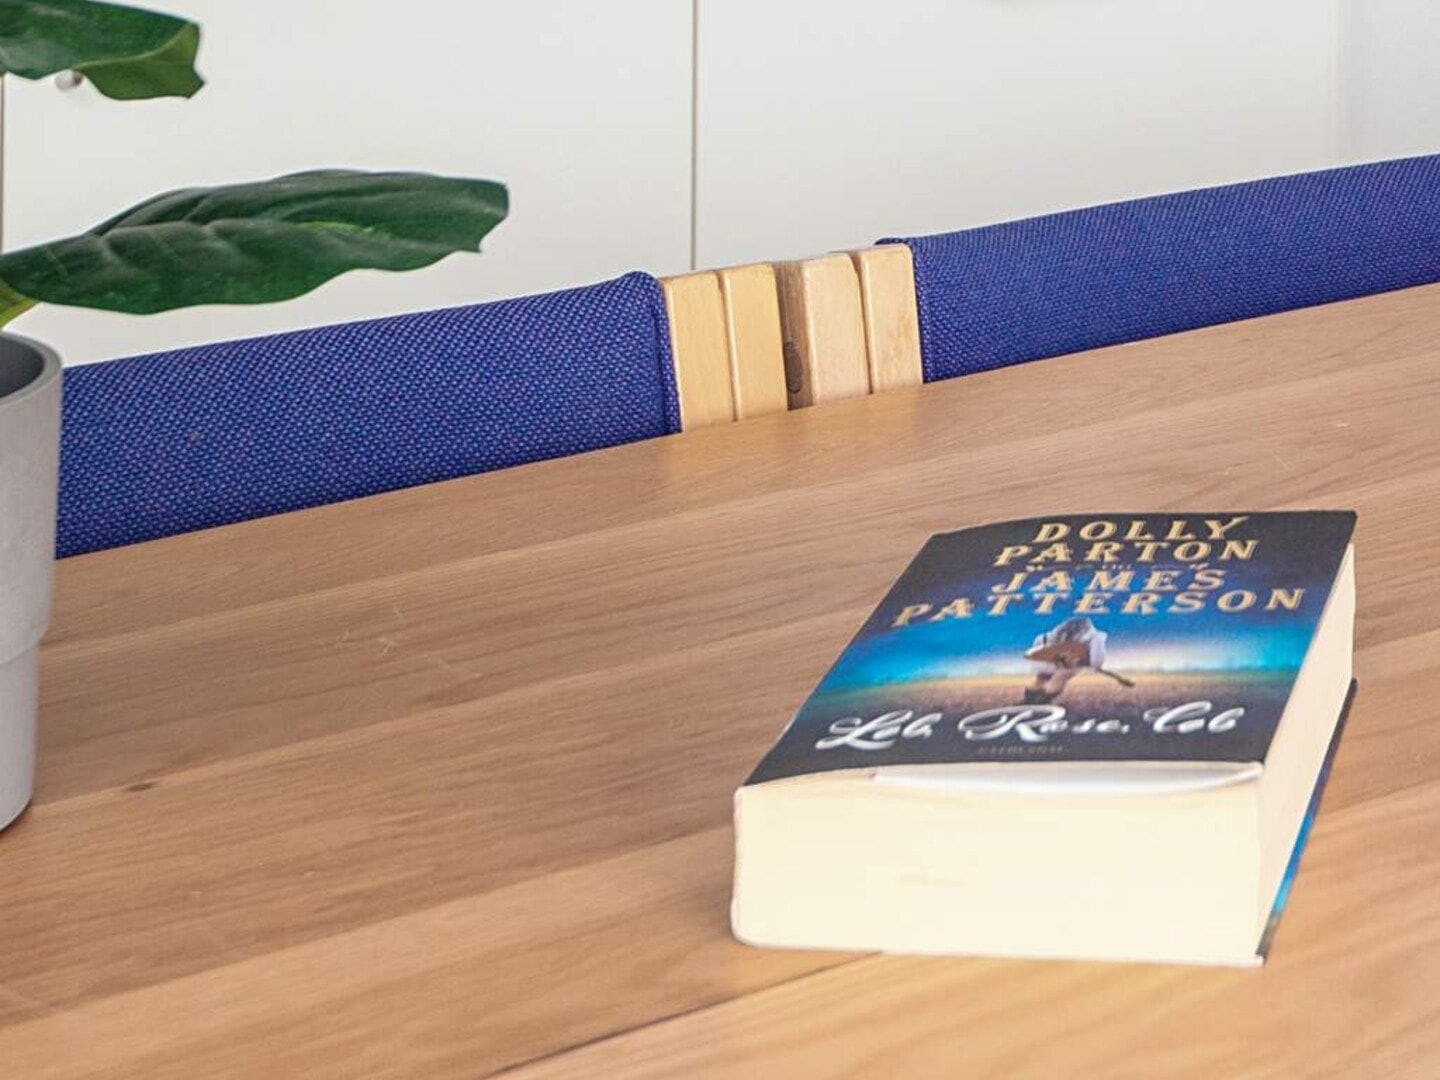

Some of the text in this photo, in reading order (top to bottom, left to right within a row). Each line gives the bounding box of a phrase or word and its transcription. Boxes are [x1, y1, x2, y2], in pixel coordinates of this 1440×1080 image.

[1031, 516, 1250, 544] DOLLY
[993, 539, 1260, 567] PARTON
[991, 568, 1227, 594] JAMES
[891, 587, 1307, 628] PATTERSON
